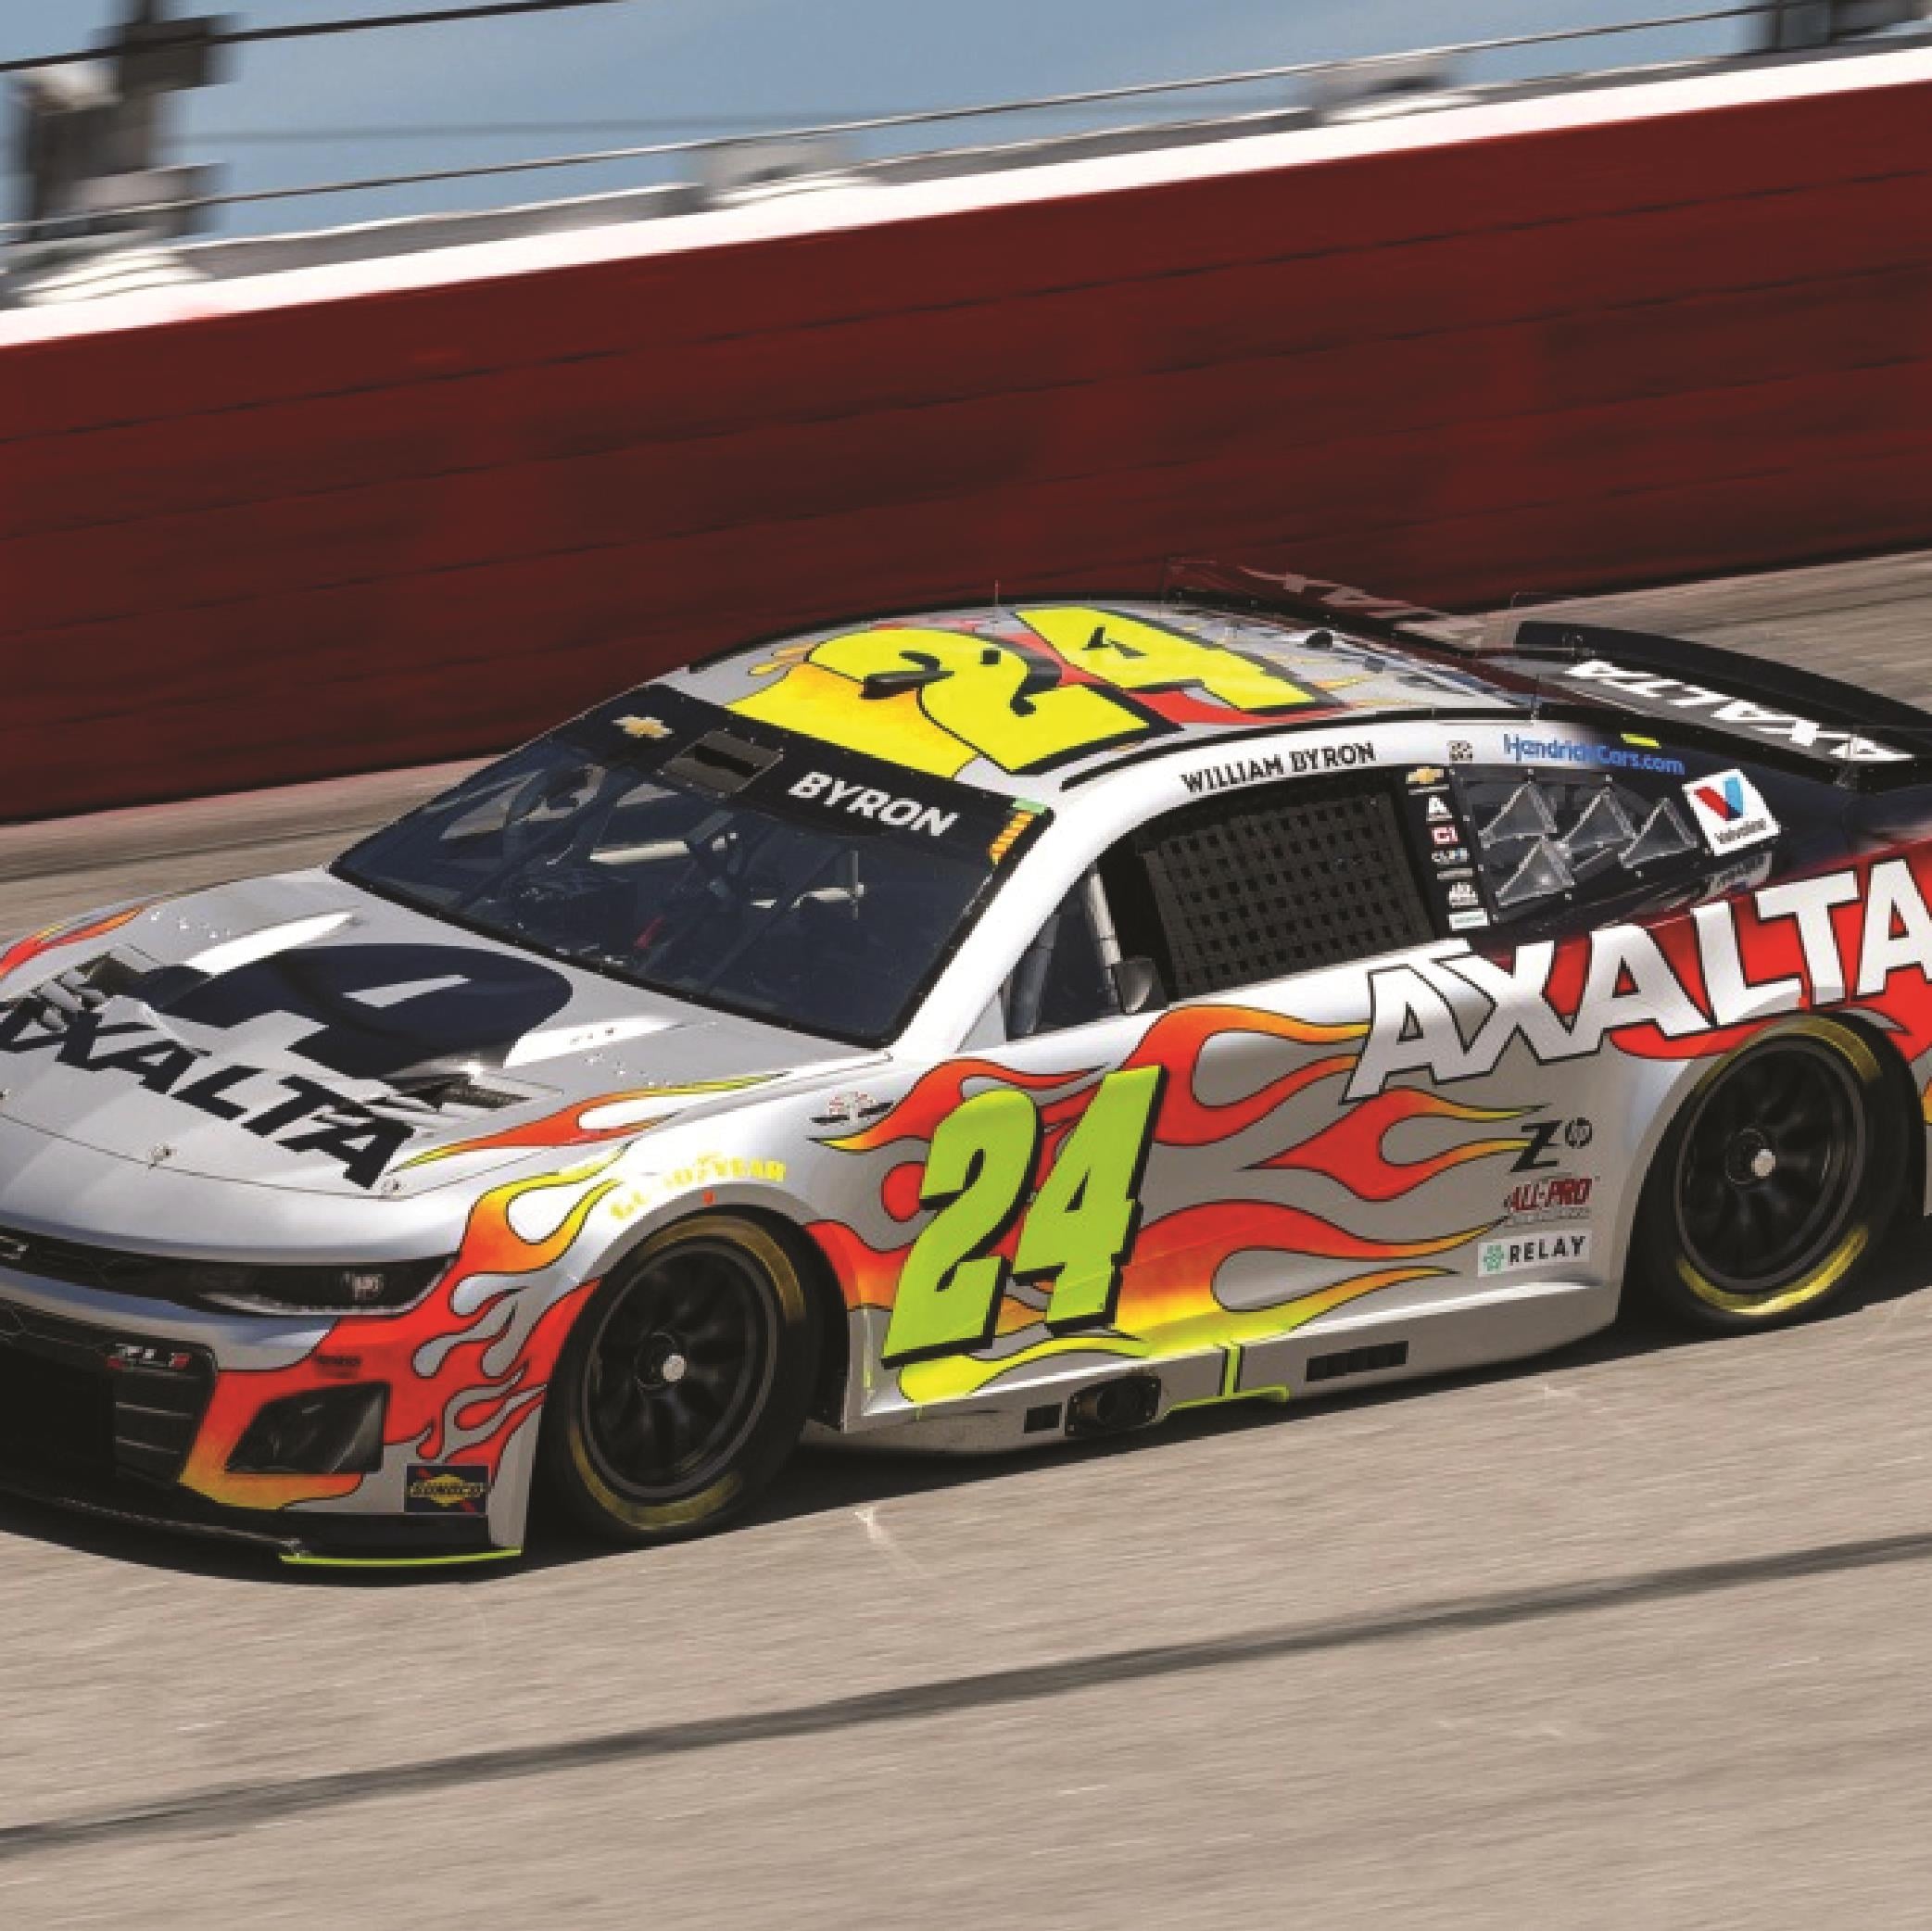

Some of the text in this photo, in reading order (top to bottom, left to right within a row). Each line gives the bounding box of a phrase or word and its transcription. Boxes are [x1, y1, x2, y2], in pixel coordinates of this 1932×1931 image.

[805, 606, 1320, 775] 24
[1179, 740, 1376, 793] WILLIAM BYRON
[789, 771, 958, 836] BYRON
[1342, 853, 1932, 1104] AXALTA
[611, 1154, 786, 1220] GODYEAR
[883, 1065, 1167, 1367] 24
[1509, 1235, 1585, 1266] RELAY
